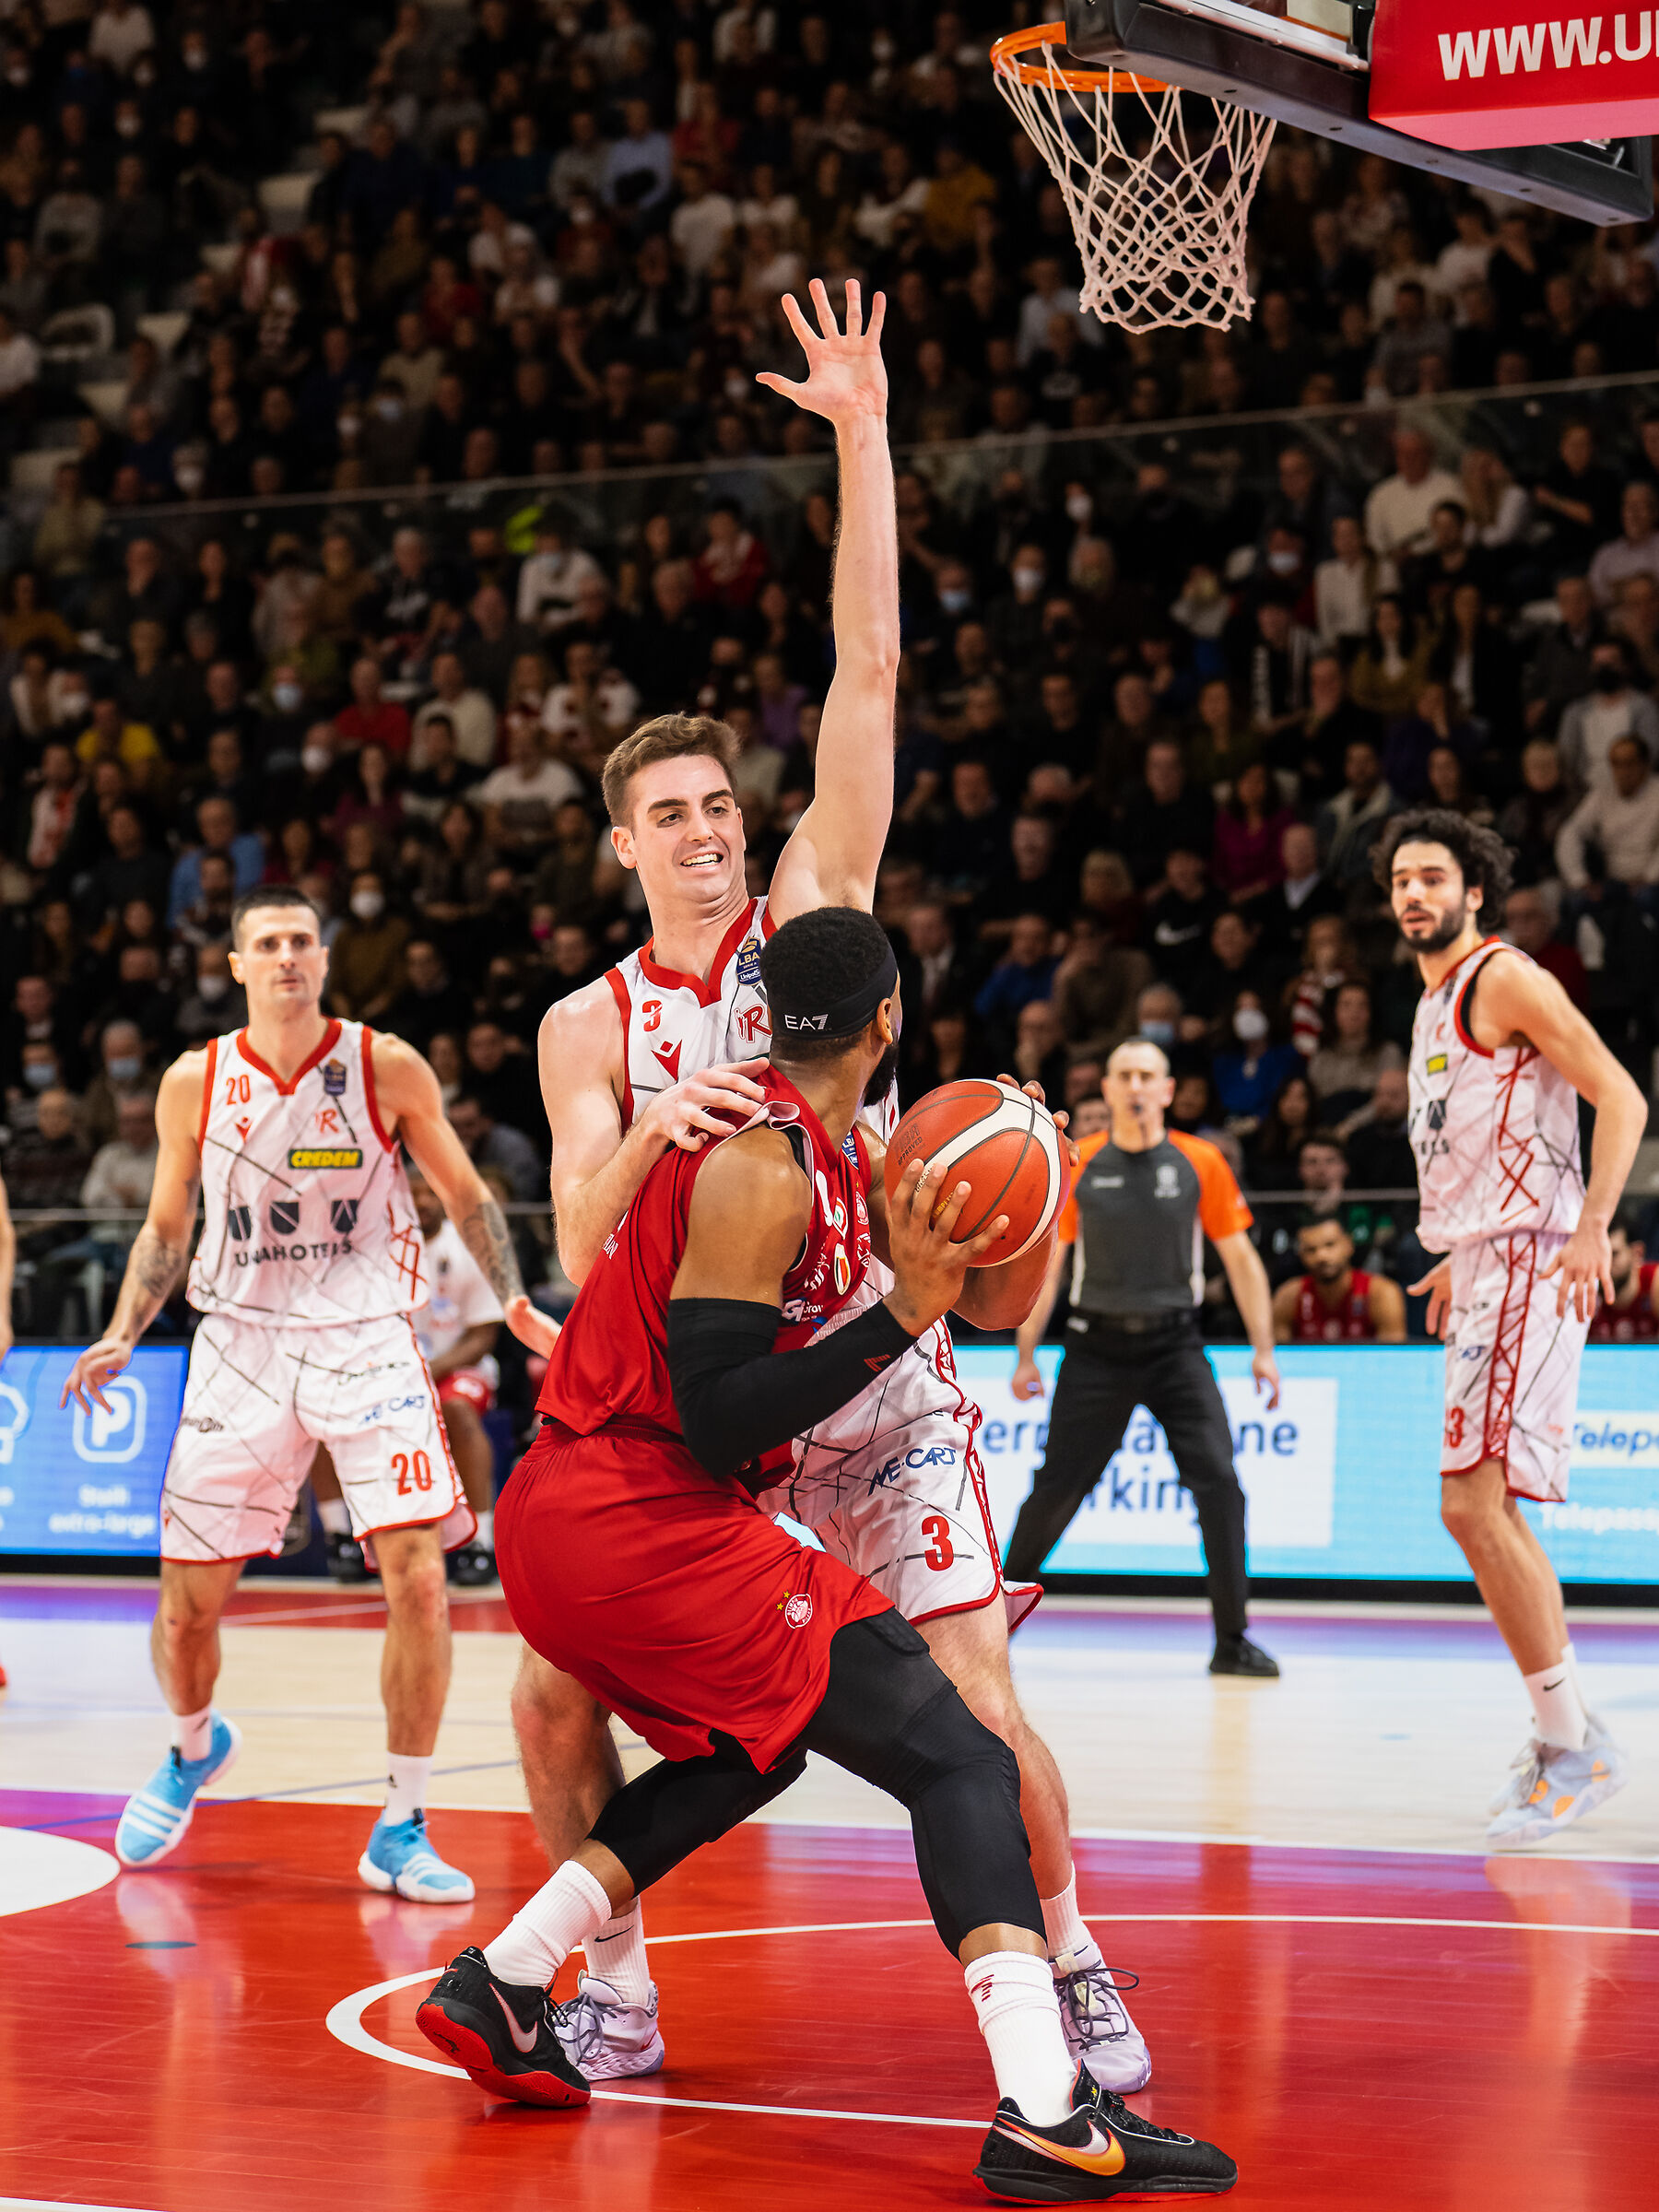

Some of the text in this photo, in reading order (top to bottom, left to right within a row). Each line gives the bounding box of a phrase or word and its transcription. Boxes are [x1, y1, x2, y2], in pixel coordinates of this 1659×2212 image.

[1438, 10, 1659, 81] WWW.U
[738, 952, 760, 966] LBA
[740, 969, 760, 980] UnipolS
[641, 1000, 663, 1032] 3
[784, 1014, 829, 1030] EA7
[226, 1075, 251, 1106] 20
[290, 1151, 360, 1168] CREDEM
[898, 1136, 923, 1166] APPROVED
[391, 1450, 433, 1496] 20
[922, 1516, 954, 1571] 3
